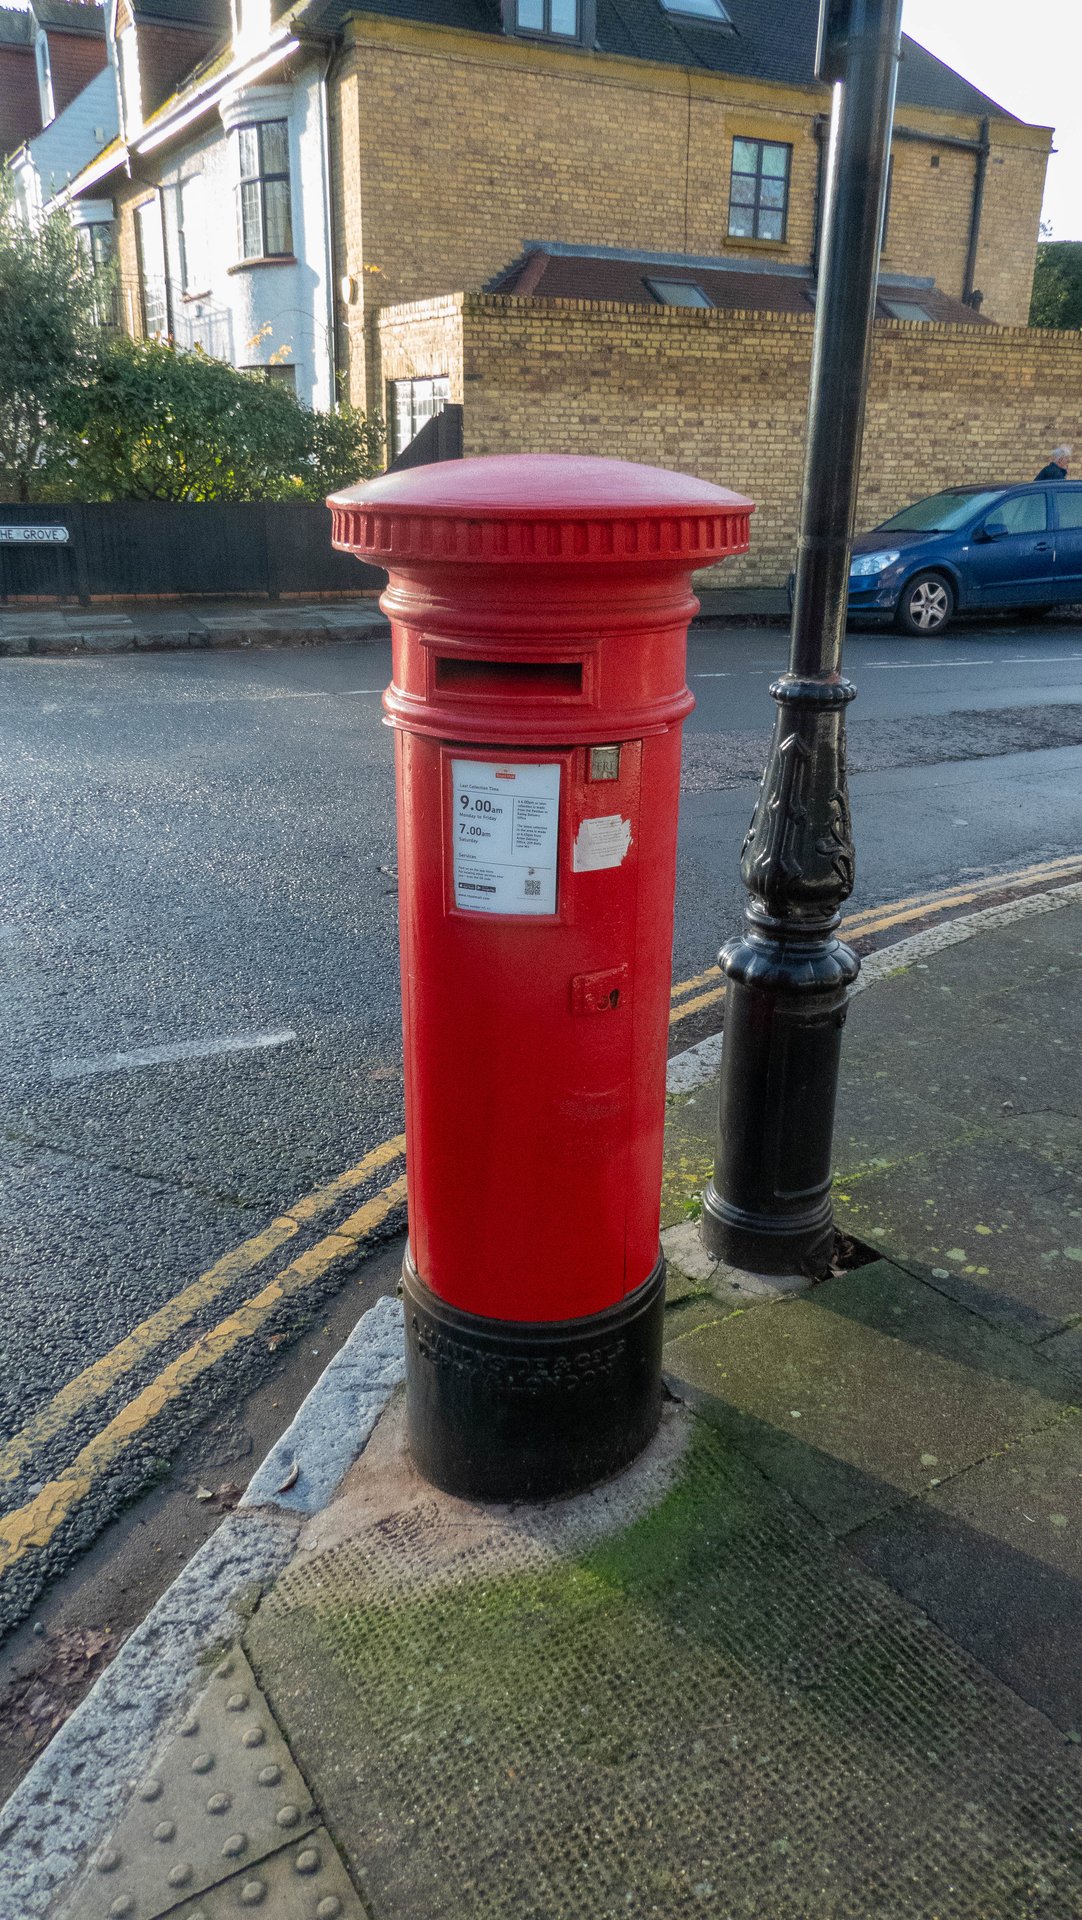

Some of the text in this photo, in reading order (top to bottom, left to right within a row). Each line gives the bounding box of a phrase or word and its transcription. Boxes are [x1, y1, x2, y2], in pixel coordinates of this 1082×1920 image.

[0, 529, 59, 540] HE GROVE
[460, 795, 503, 814] 9.00am
[459, 812, 477, 820] Monday
[459, 823, 491, 838] 7.00am
[458, 836, 478, 845] Saturday
[458, 851, 477, 860] Services
